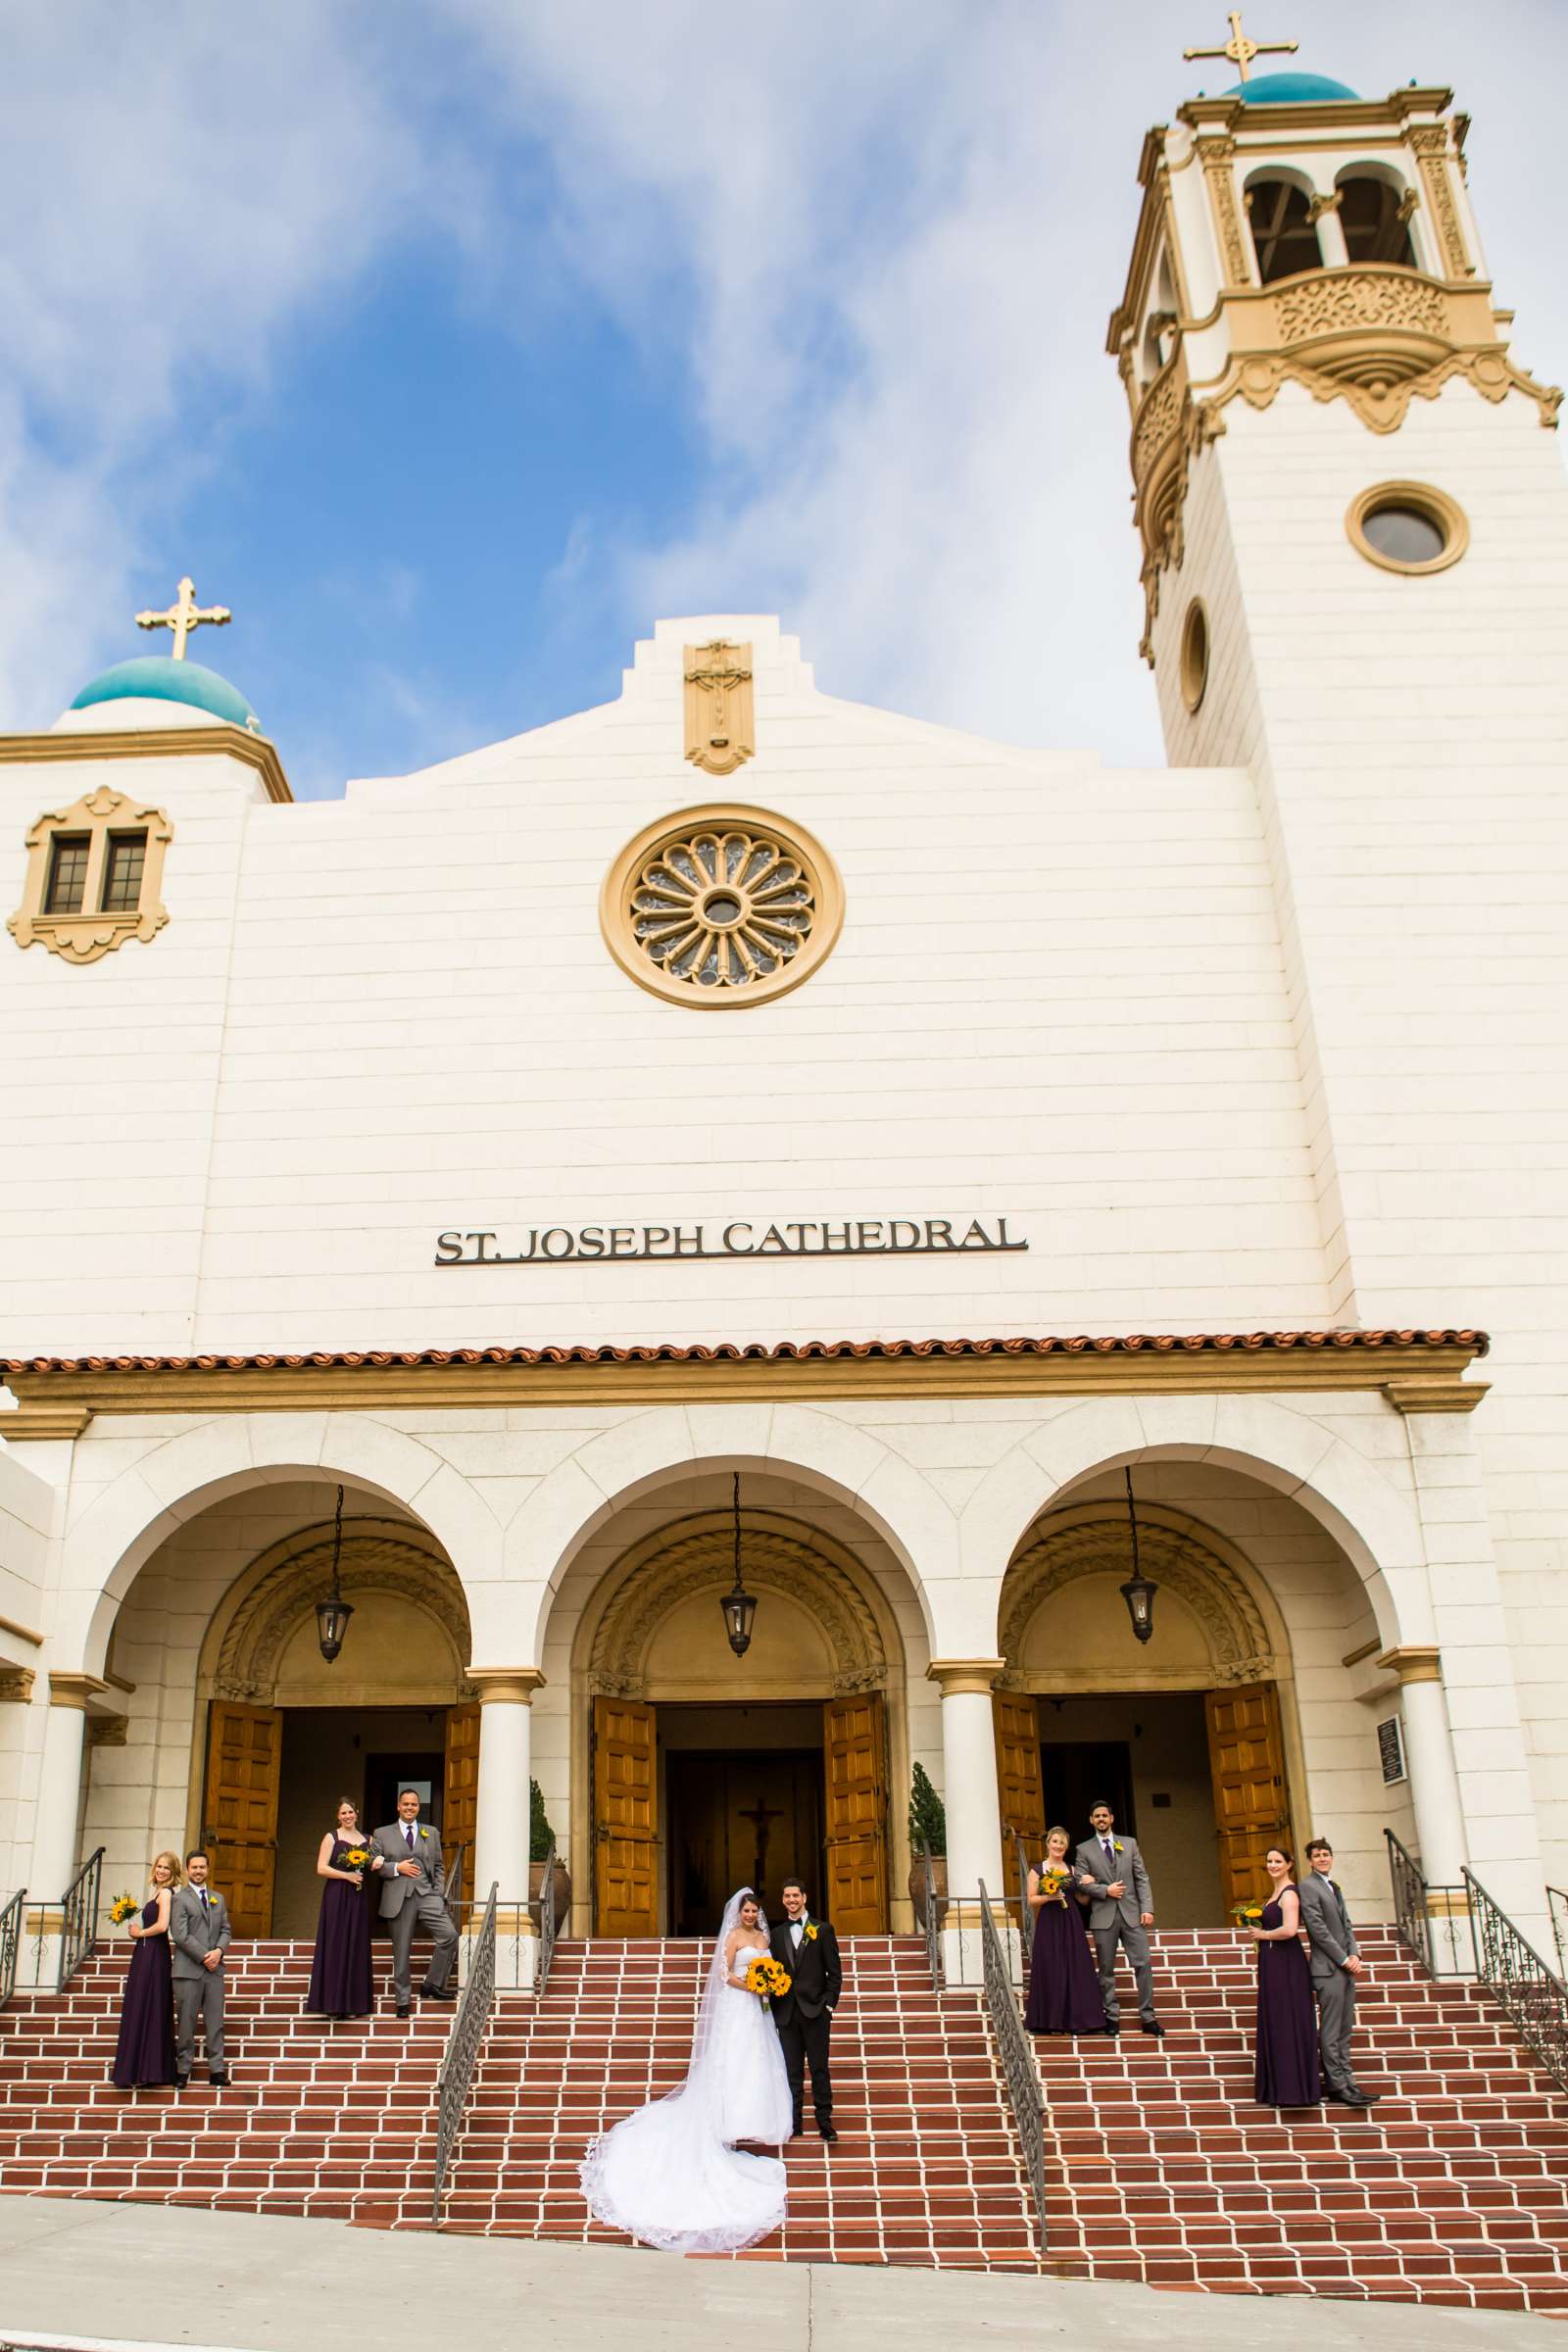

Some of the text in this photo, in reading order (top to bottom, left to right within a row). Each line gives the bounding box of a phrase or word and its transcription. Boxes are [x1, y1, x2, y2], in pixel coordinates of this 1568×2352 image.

[436, 1218, 1027, 1260] ST. JOSEPH CATHEDRAL
